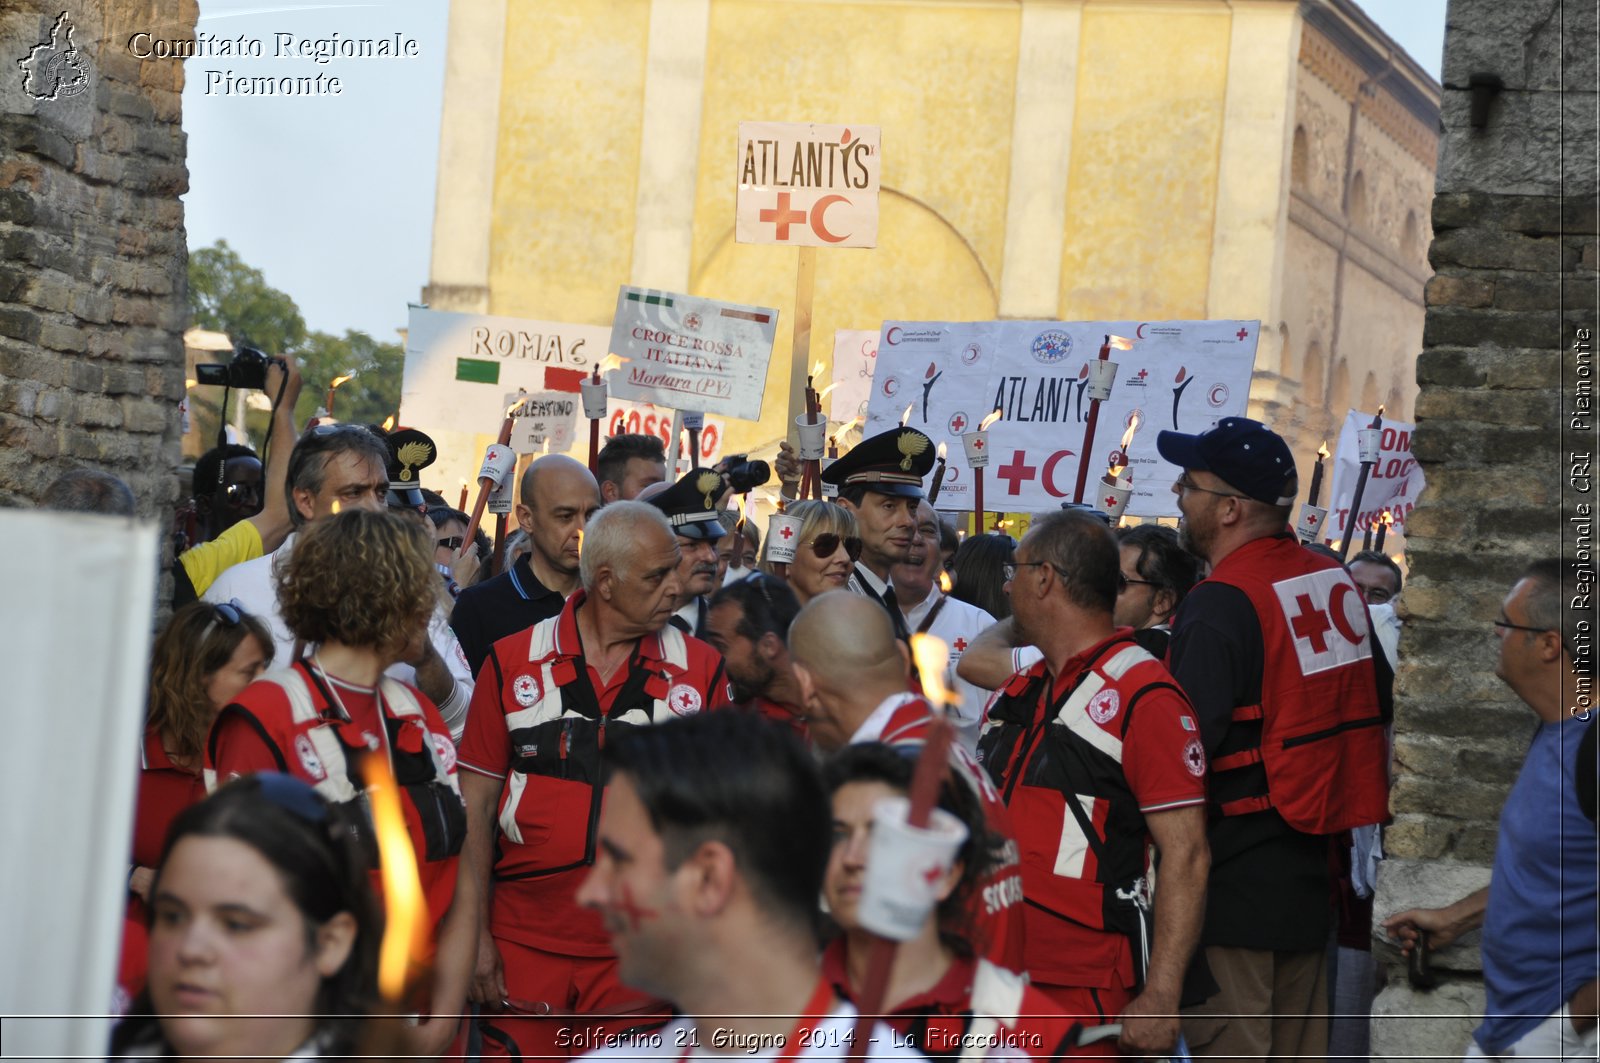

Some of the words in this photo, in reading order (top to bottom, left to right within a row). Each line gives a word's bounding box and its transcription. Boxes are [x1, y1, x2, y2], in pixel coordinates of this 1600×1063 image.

[631, 327, 689, 349] CROCE
[693, 338, 743, 358] ROSSA
[645, 348, 724, 372] ITALIANA
[628, 367, 691, 390] Mortara
[696, 378, 732, 396] (PV)
